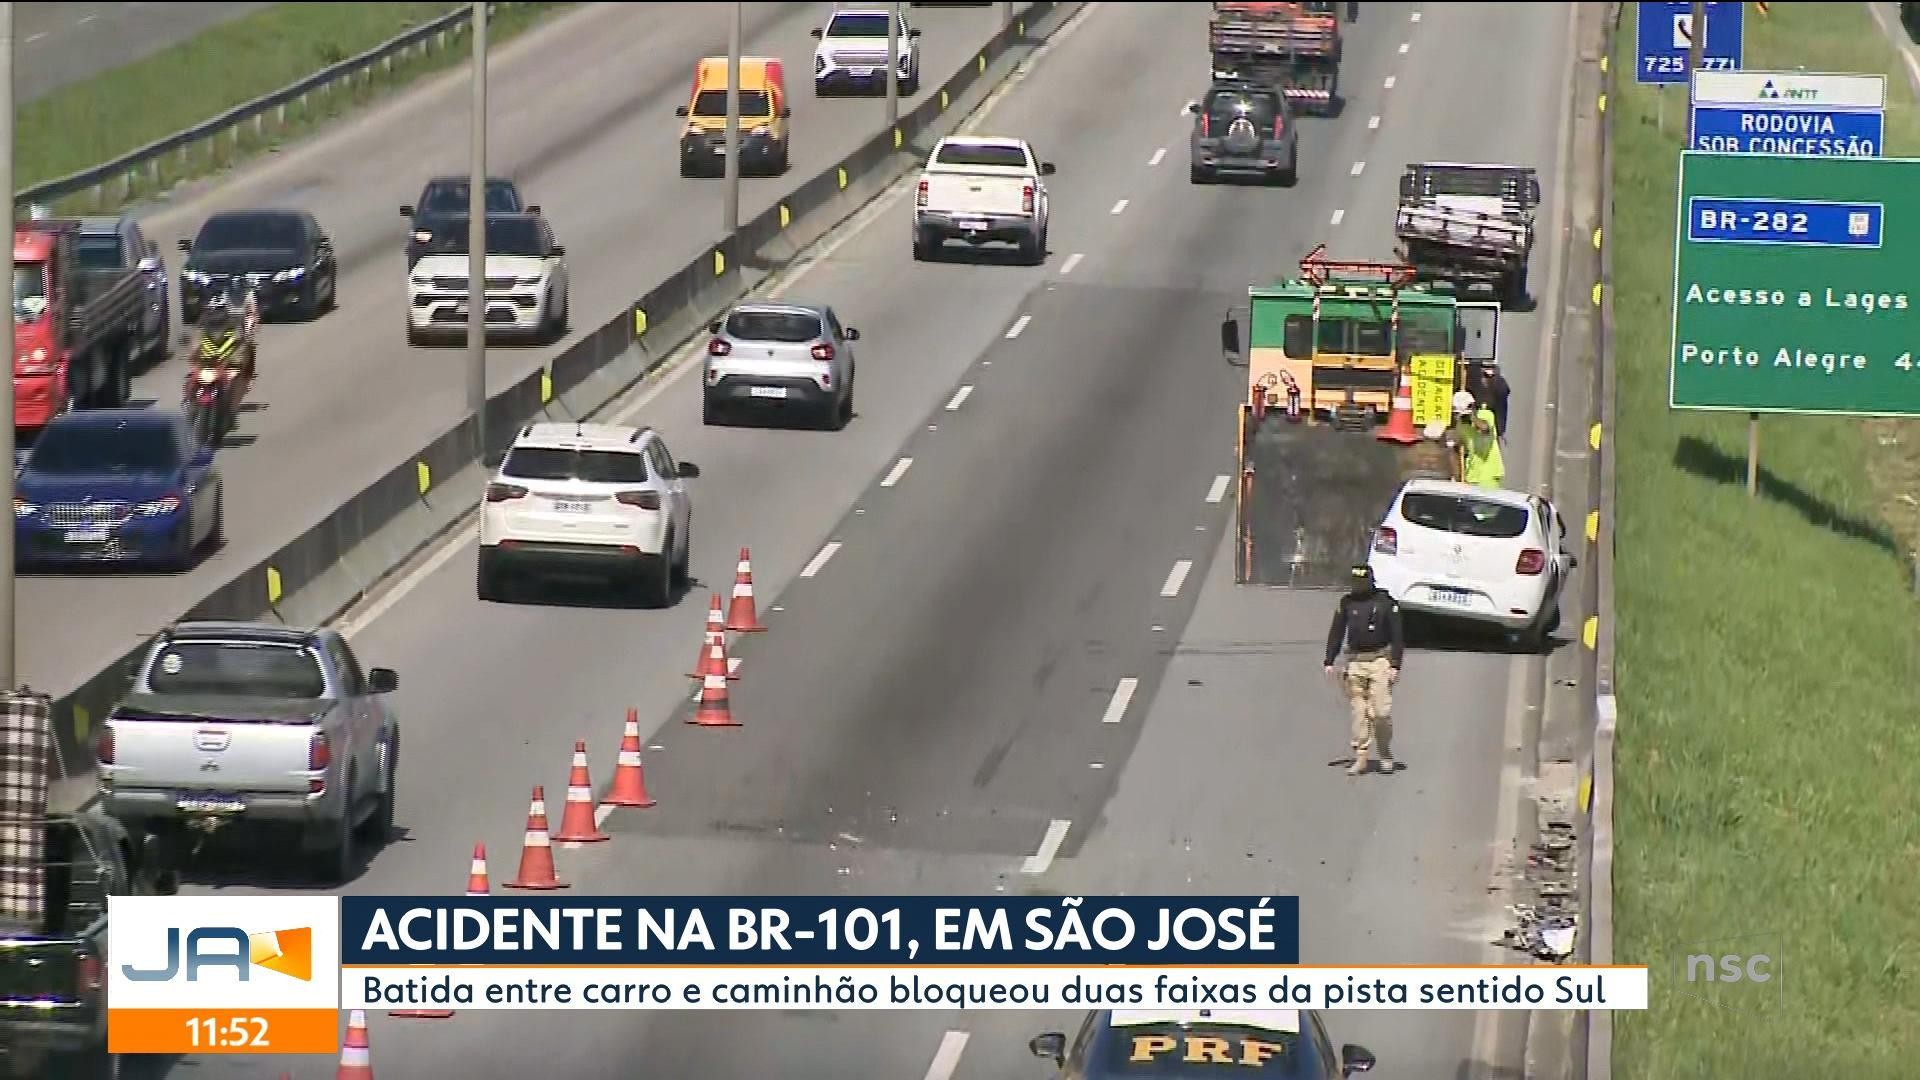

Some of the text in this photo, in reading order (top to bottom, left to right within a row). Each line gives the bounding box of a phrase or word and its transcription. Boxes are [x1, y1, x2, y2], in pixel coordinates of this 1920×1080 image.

[1644, 57, 1684, 73] 725
[1741, 113, 1835, 134] RODOVIA
[1698, 135, 1874, 157] SOB CONCESSÃO
[1700, 209, 1809, 233] BR-282
[1685, 284, 1909, 314] Acesso a Lages
[1681, 344, 1920, 374] Porto Alegre 4
[1415, 359, 1427, 423] ACDENTE
[1130, 1034, 1282, 1067] PRF
